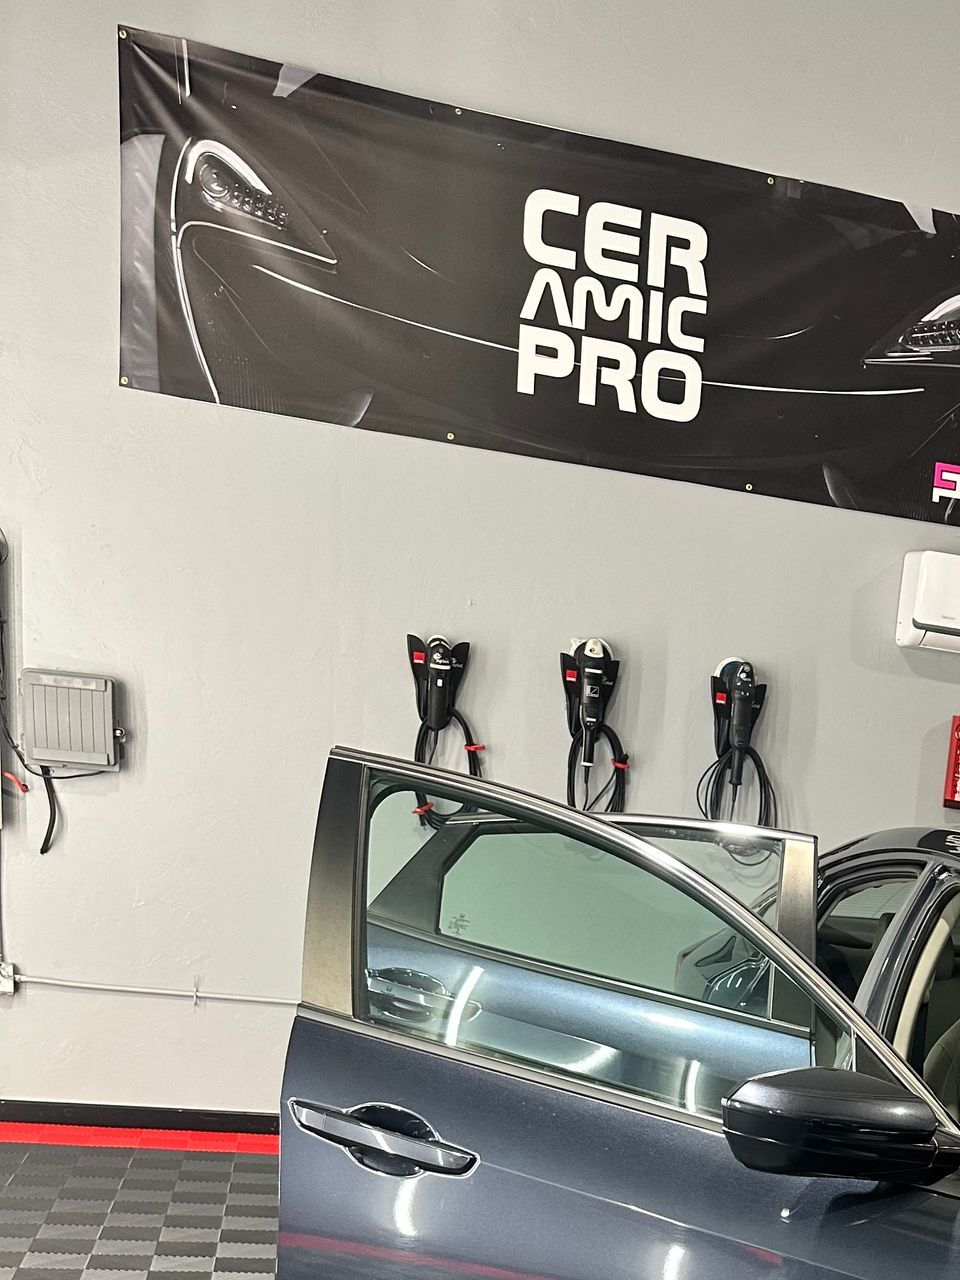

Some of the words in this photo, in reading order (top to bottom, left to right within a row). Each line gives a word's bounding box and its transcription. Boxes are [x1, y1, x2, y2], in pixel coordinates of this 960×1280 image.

[523, 188, 708, 297] CER
[519, 267, 708, 353] AMIC
[516, 323, 703, 422] PRO
